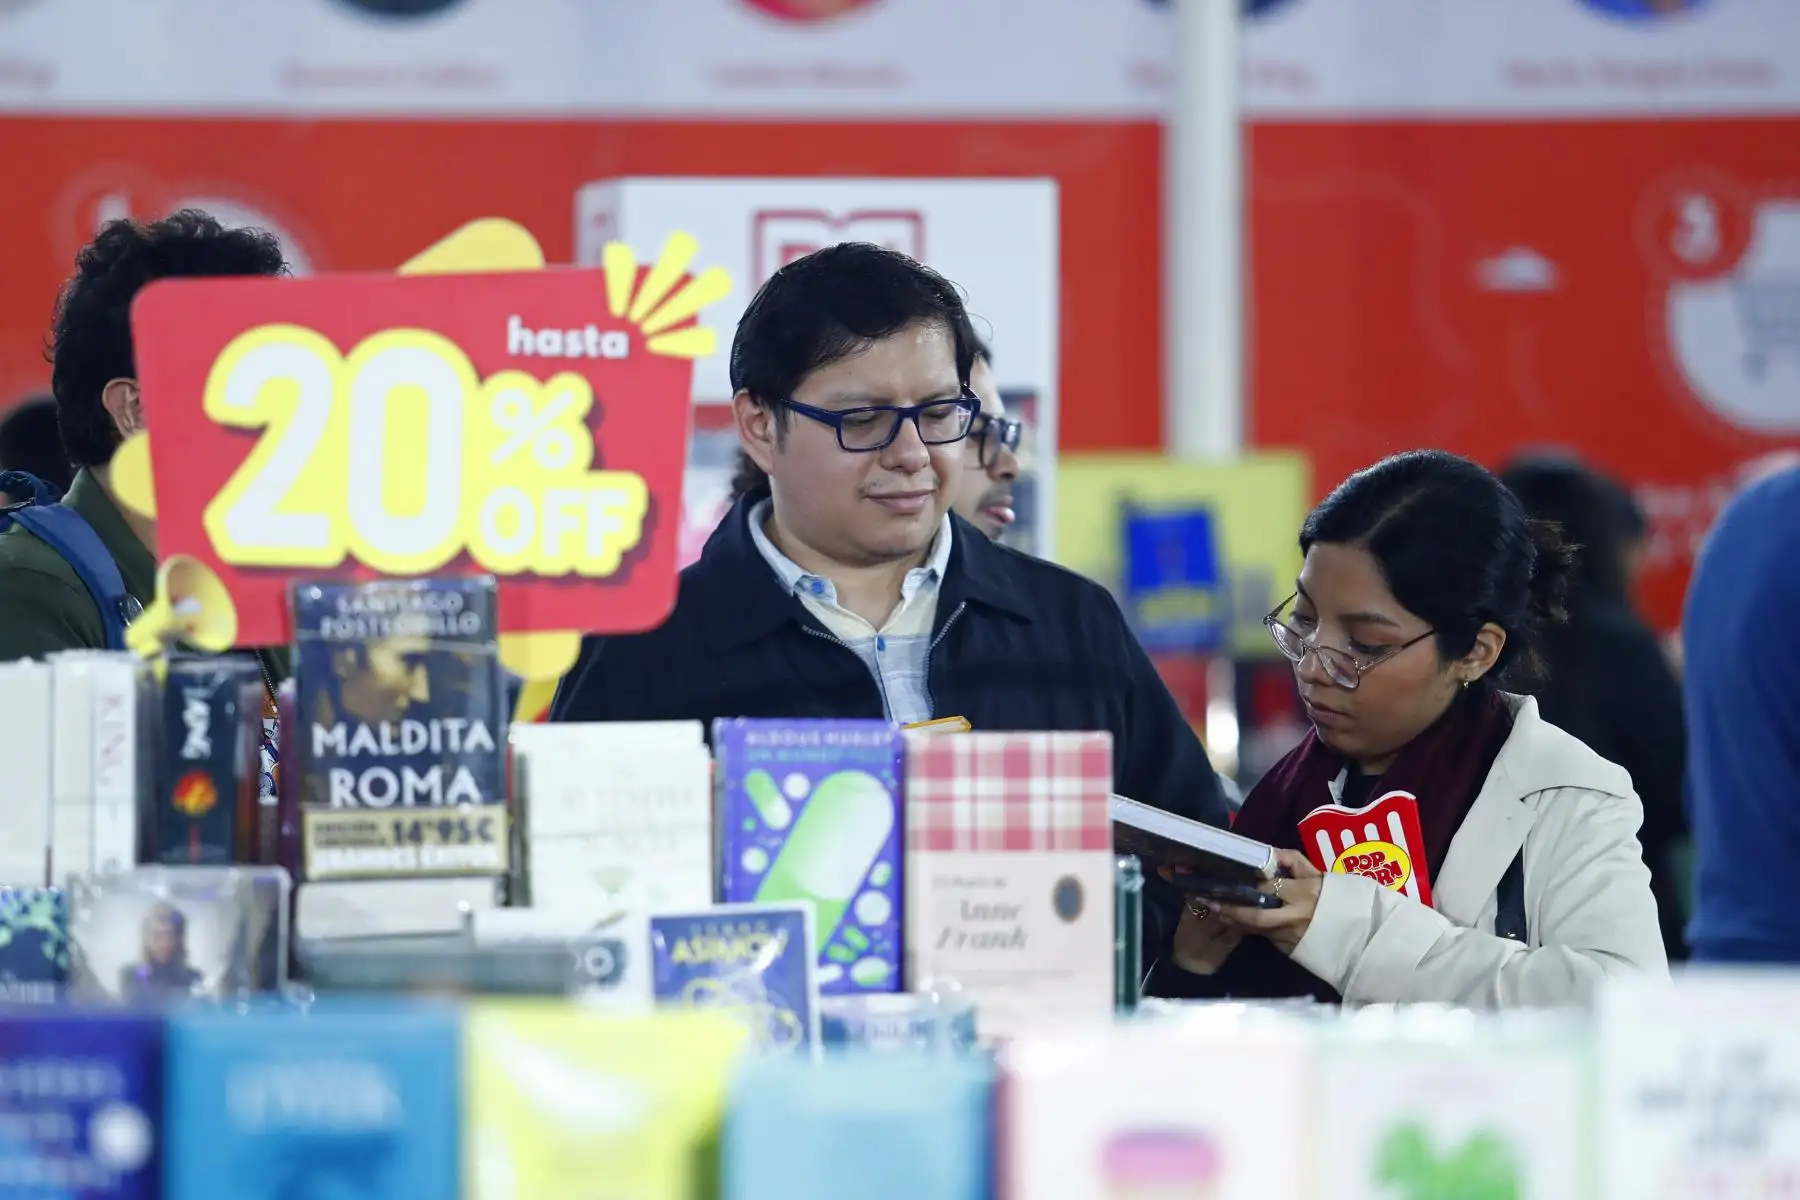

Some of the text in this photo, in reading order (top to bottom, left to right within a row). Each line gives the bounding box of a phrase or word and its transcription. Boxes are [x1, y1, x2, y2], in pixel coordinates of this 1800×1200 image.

[506, 315, 629, 359] hasta
[480, 487, 630, 559] OFF
[311, 717, 496, 758] MALDITA
[328, 764, 482, 810] ROMA
[1341, 850, 1387, 874] POP
